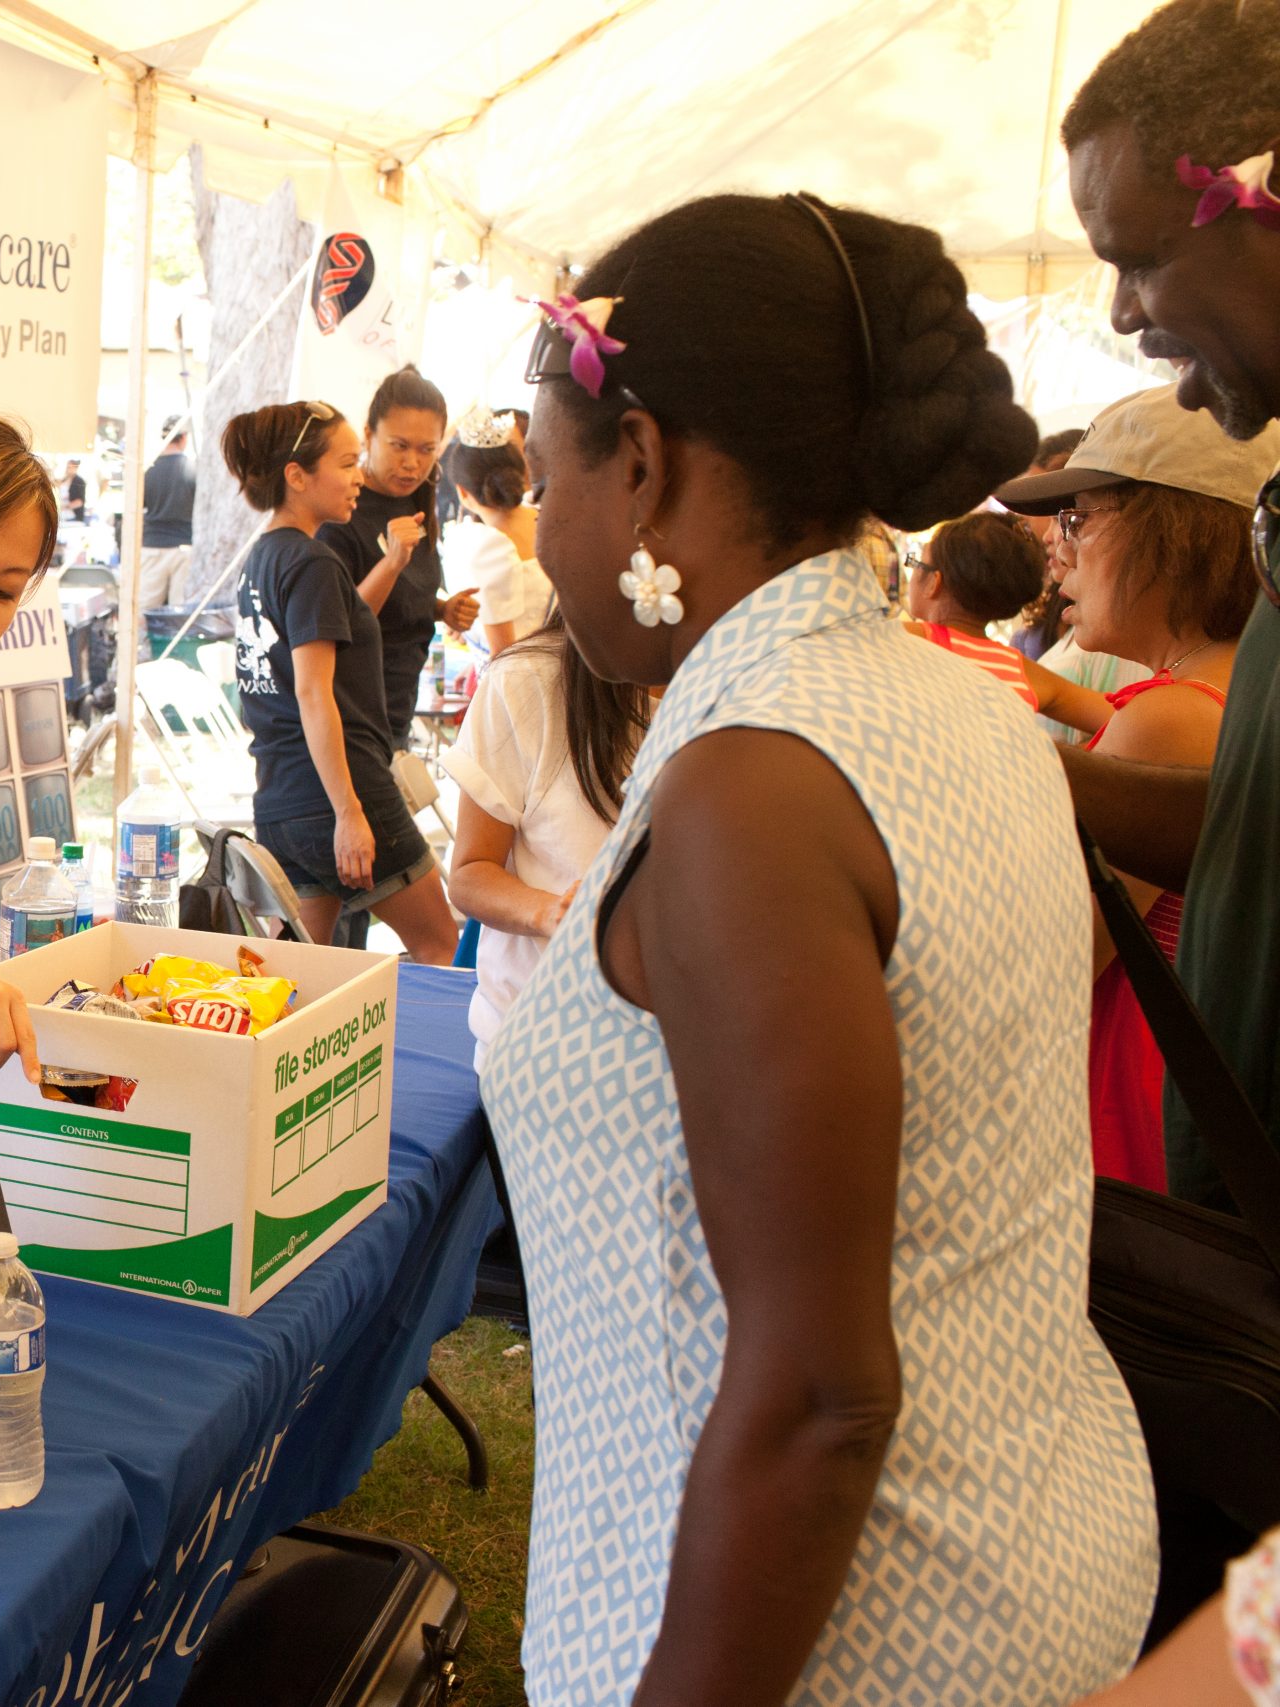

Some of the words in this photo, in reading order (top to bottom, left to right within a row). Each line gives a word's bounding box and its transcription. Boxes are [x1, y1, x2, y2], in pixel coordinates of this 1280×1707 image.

[19, 319, 67, 356] Plan
[274, 1050, 299, 1094] file
[303, 1014, 360, 1076] storage
[362, 997, 387, 1038] box
[284, 1112, 294, 1125] BOX
[60, 1124, 109, 1141] CONTENTS
[120, 1271, 181, 1290] INTERNATIONAL
[198, 1285, 222, 1297] PAPER
